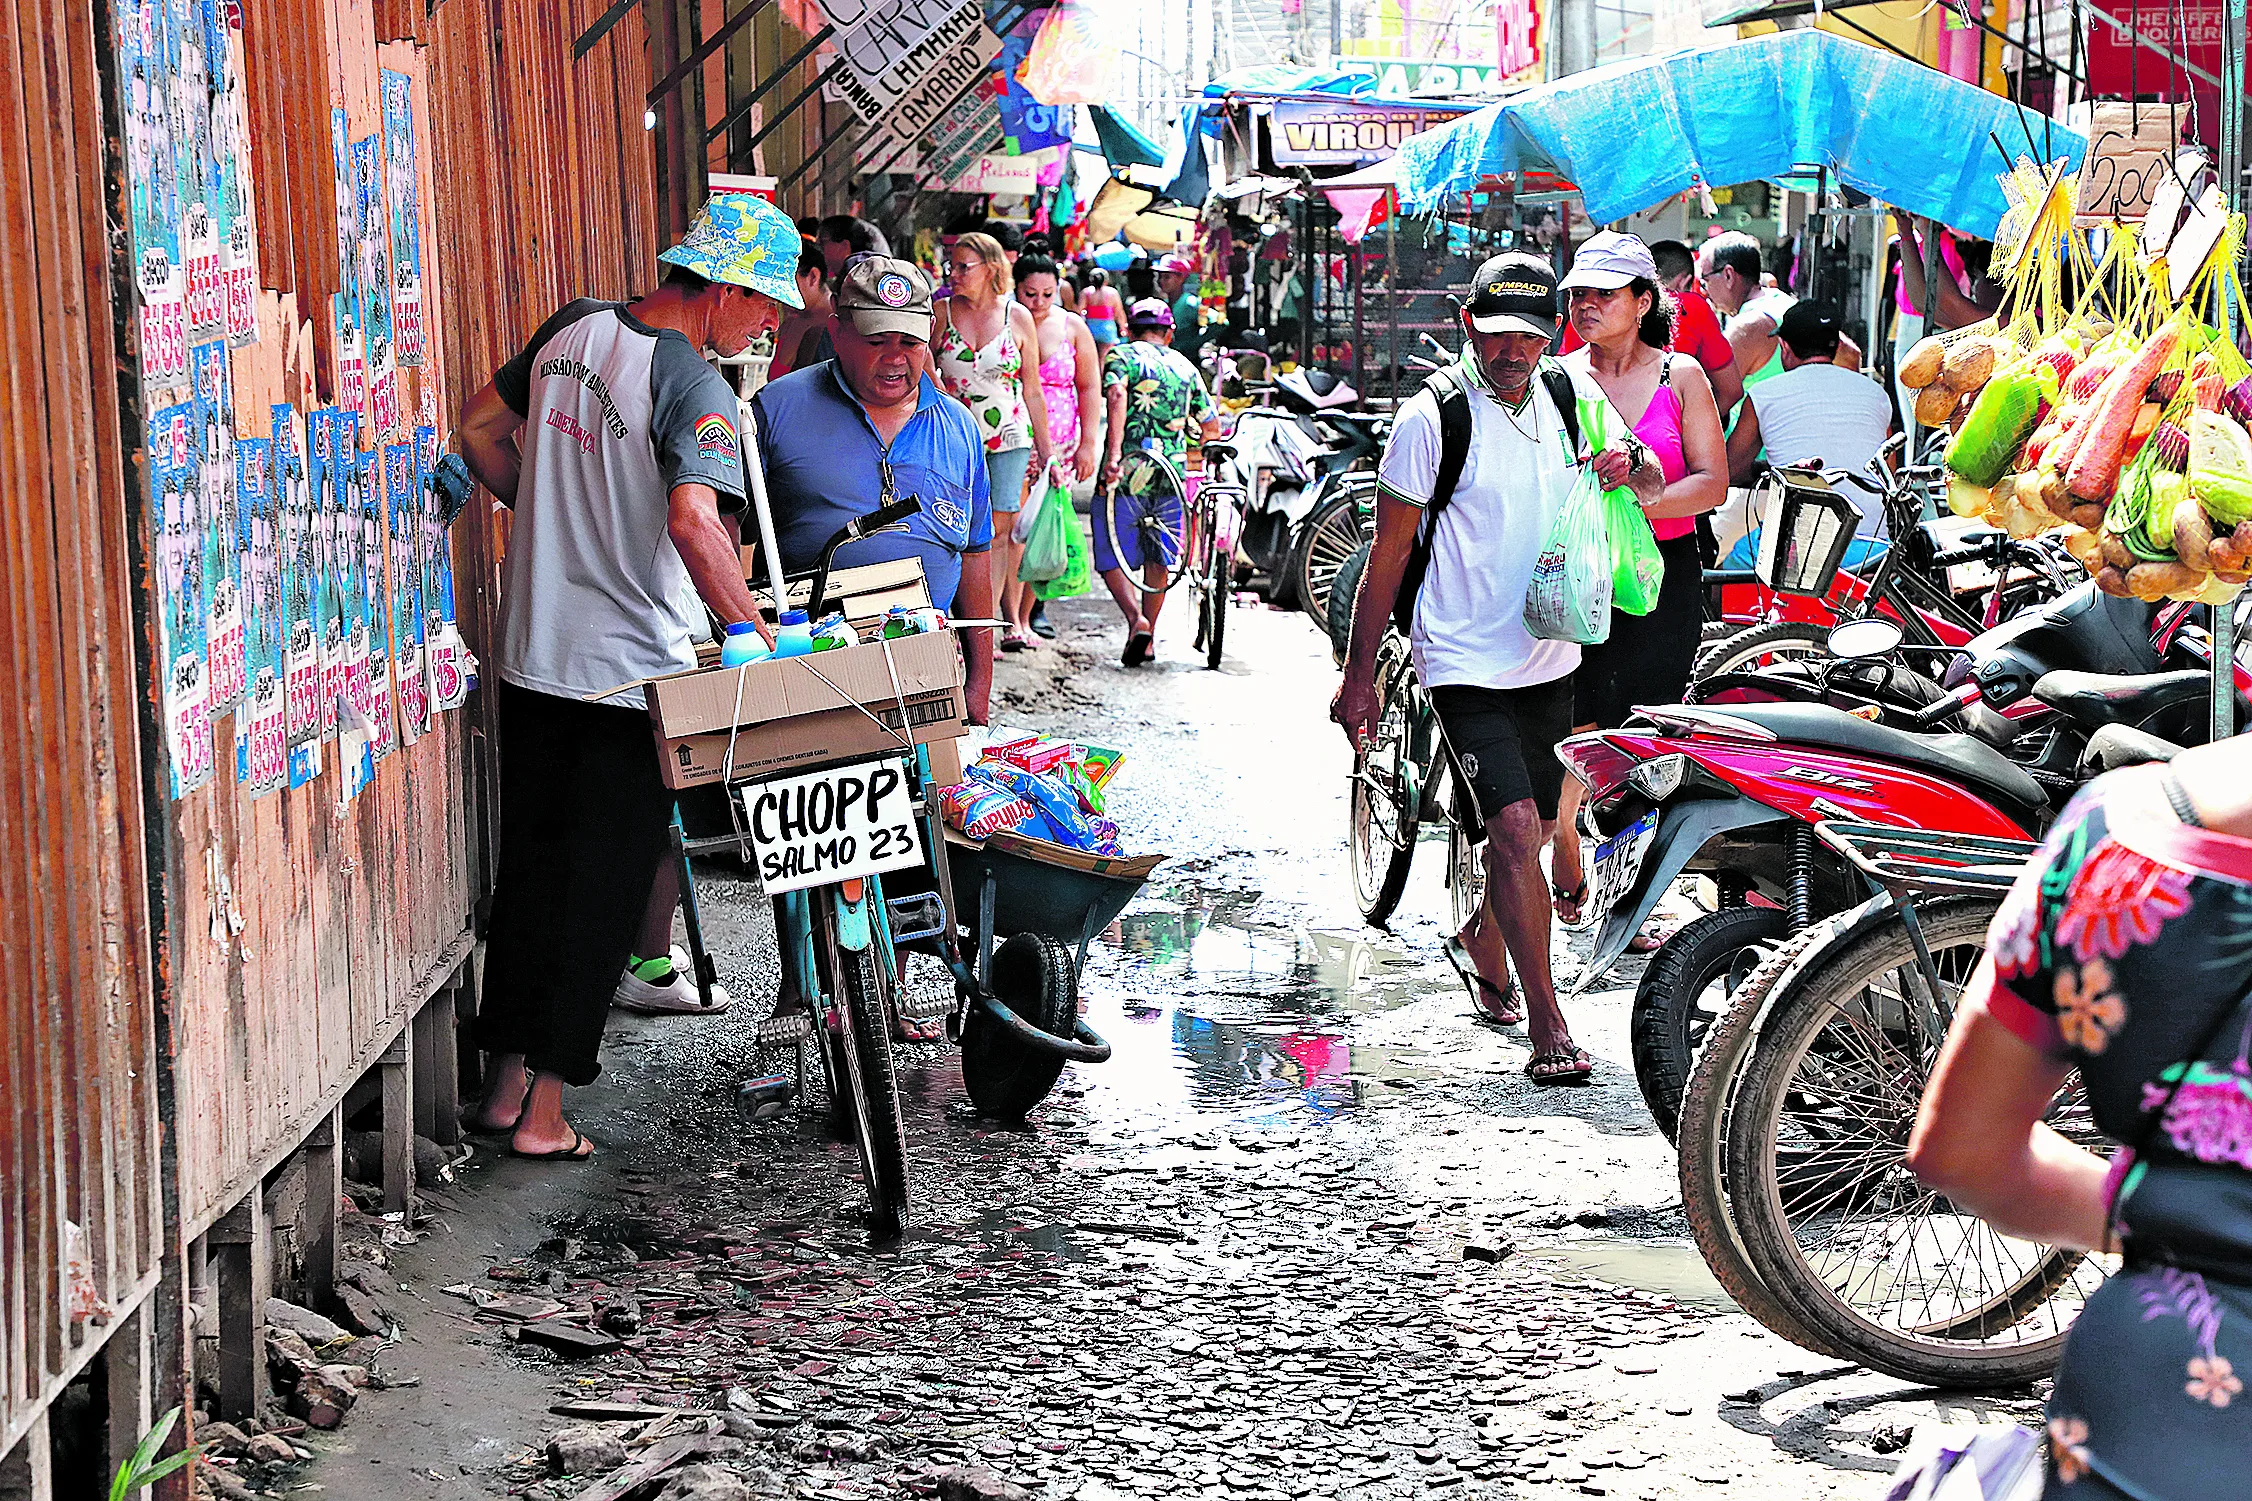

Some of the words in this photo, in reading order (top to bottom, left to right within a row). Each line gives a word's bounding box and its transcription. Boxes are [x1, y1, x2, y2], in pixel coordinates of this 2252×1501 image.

[835, 67, 883, 121] BANCA
[1284, 122, 1415, 151] VIROU
[1502, 281, 1549, 294] IMPACTO
[763, 836, 857, 881] SALMO
[868, 824, 914, 861] 23
[1613, 829, 1637, 849] BRASIL
